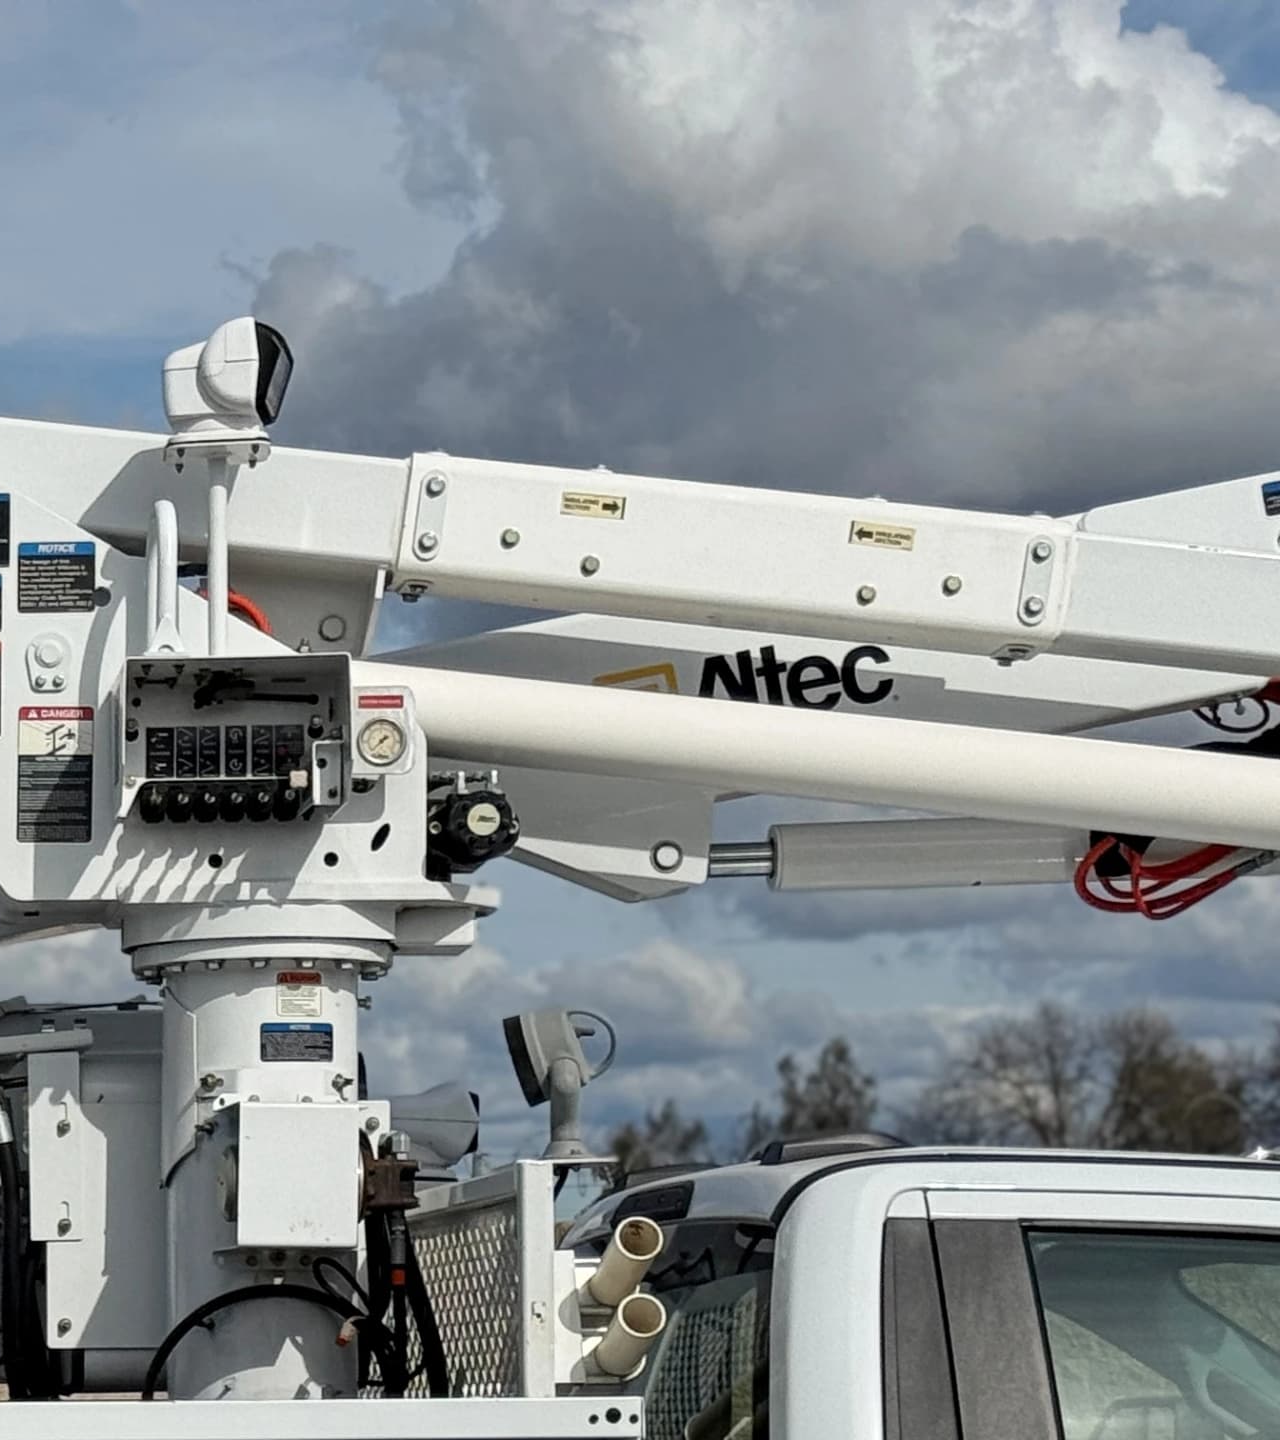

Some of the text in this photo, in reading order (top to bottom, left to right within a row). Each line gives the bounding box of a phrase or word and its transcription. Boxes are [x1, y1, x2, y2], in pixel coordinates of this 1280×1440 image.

[38, 544, 77, 553] NOTICE
[698, 644, 894, 711] Altec
[40, 709, 84, 719] DANGER
